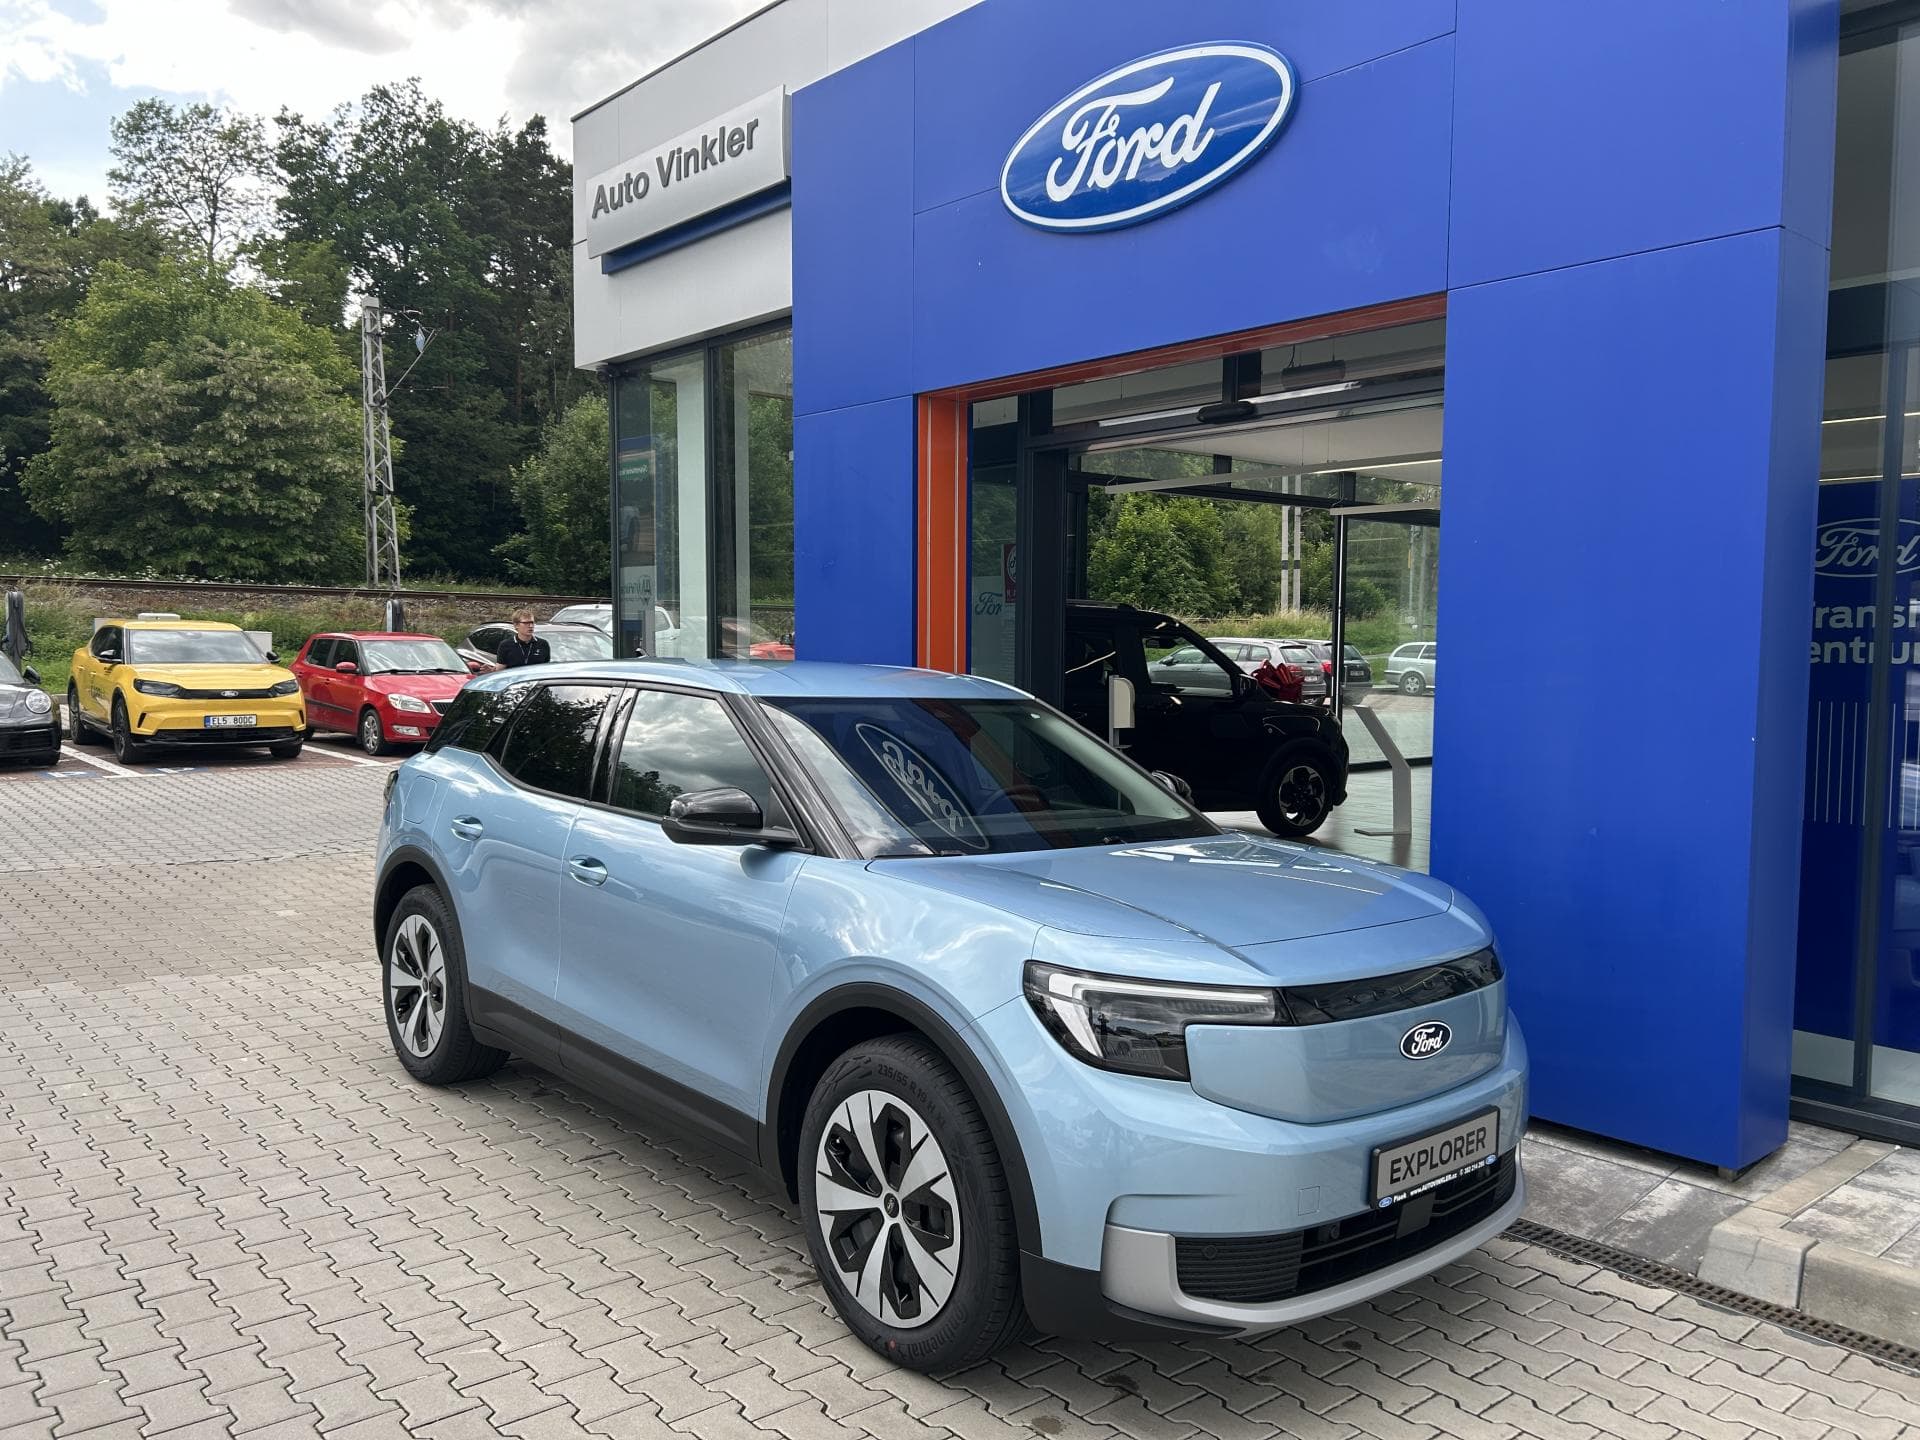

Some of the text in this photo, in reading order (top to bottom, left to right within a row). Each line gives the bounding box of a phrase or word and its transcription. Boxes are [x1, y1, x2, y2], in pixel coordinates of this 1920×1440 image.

[1045, 76, 1222, 203] Ford
[591, 118, 759, 219] Auto Vinkler
[975, 591, 1003, 615] For
[1814, 600, 1920, 628] ransi
[1411, 1026, 1443, 1055] Ford
[878, 1063, 908, 1086] 235/55
[1389, 1126, 1487, 1185] EXPLORER
